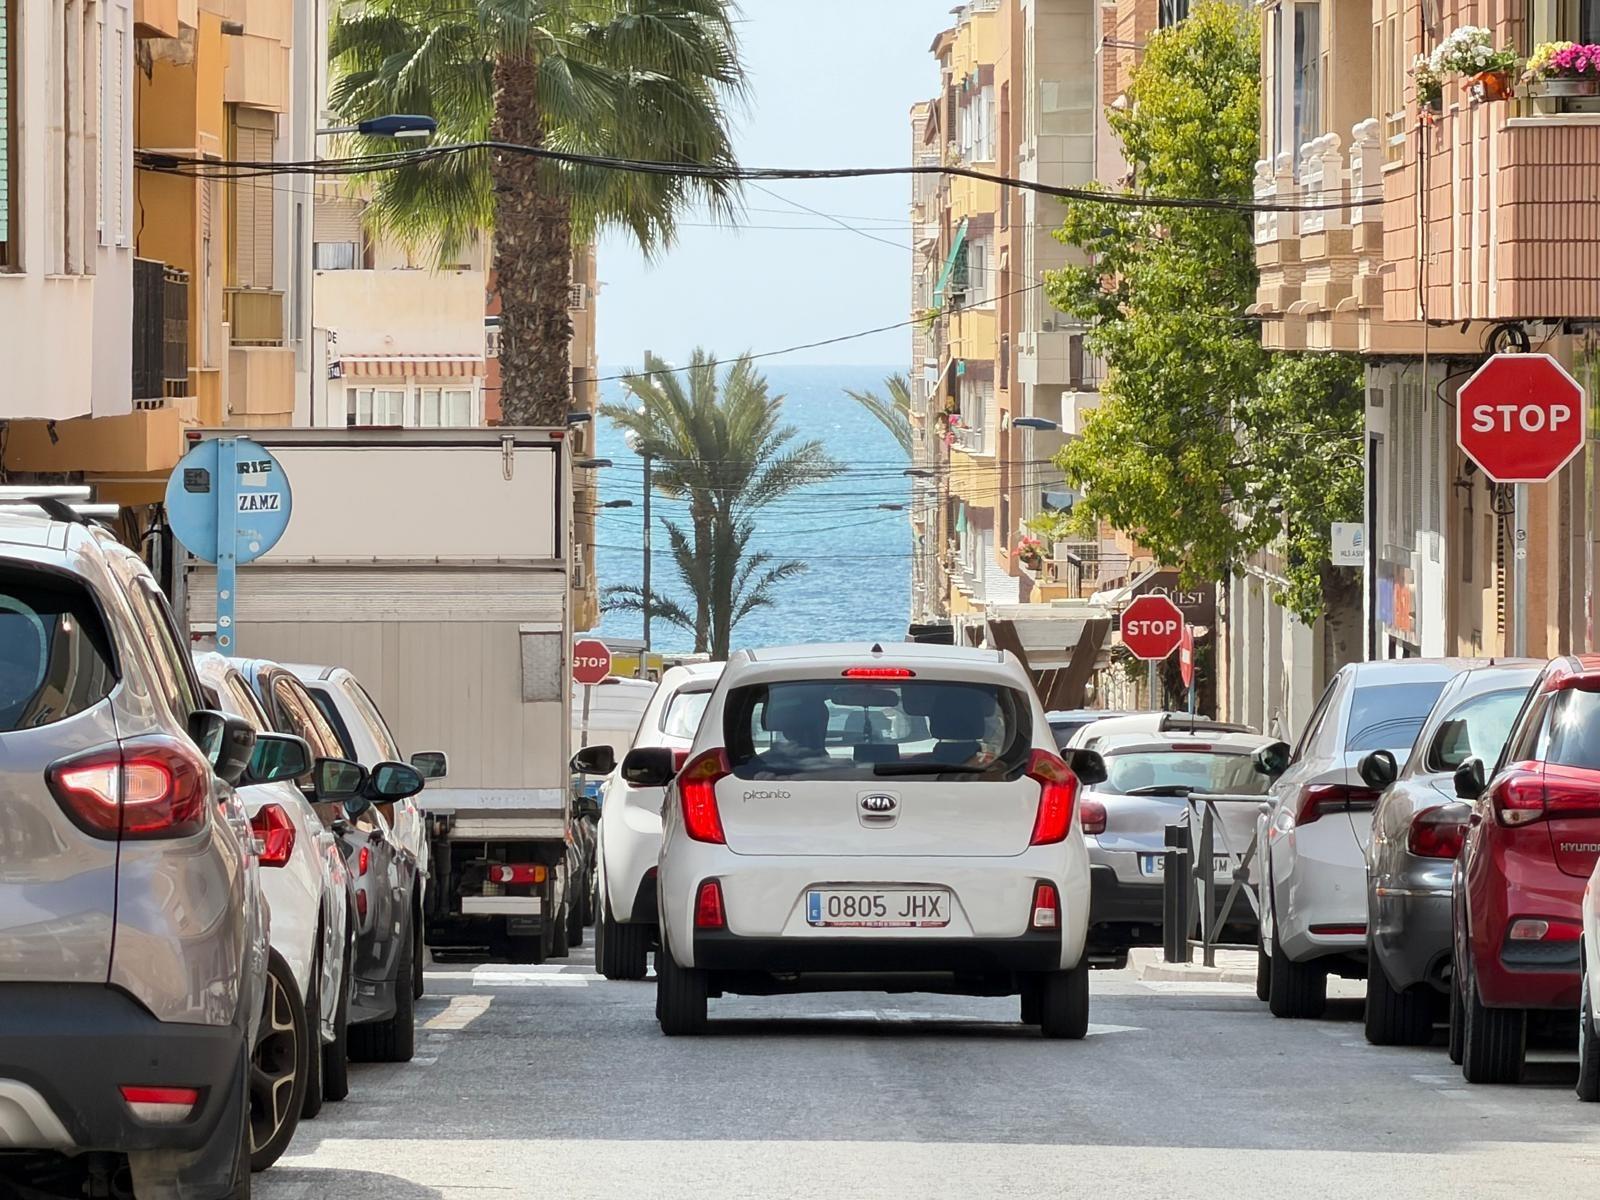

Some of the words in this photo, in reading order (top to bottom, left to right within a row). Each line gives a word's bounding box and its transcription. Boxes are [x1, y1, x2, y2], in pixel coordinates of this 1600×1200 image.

[1471, 404, 1571, 433] STOP
[239, 494, 279, 511] ZAMZ
[1127, 620, 1177, 636] STOP
[573, 656, 607, 668] STOP
[743, 790, 791, 803] picanto
[867, 797, 891, 809] KIA
[828, 895, 887, 918] 0805
[898, 895, 942, 918] JHX
